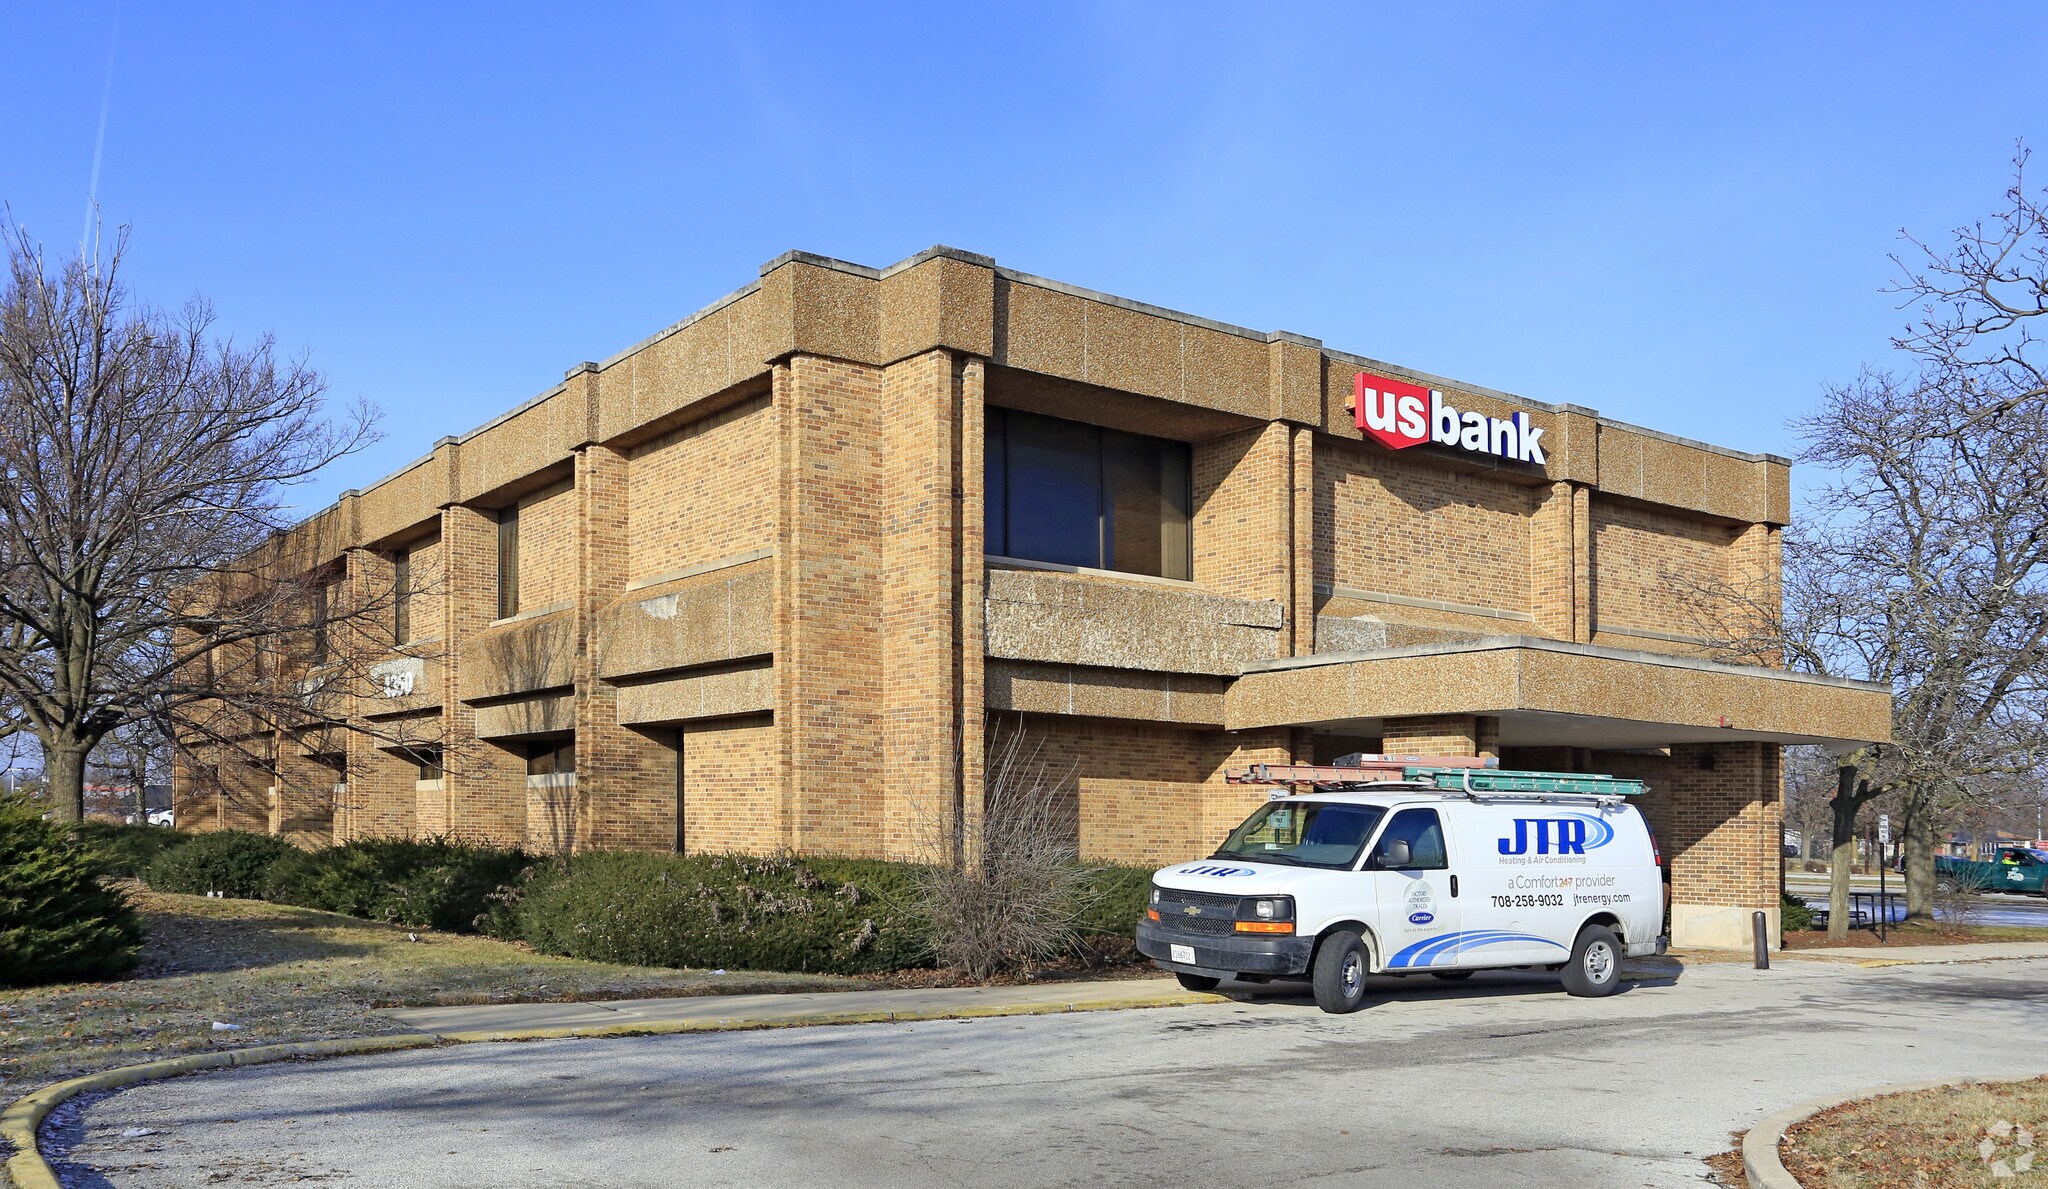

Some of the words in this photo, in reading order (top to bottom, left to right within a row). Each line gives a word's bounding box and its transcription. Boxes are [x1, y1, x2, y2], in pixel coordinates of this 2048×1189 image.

[1497, 818, 1586, 855] JTR
[1499, 856, 1526, 866] Heating
[1527, 856, 1532, 864] &
[1533, 856, 1544, 864] Air
[1545, 855, 1586, 864] Conditioning
[1179, 865, 1241, 877] JTR
[1575, 874, 1616, 890] provider
[1491, 894, 1564, 908] 708-258-9032
[1573, 893, 1632, 907] jtrenergy.com
